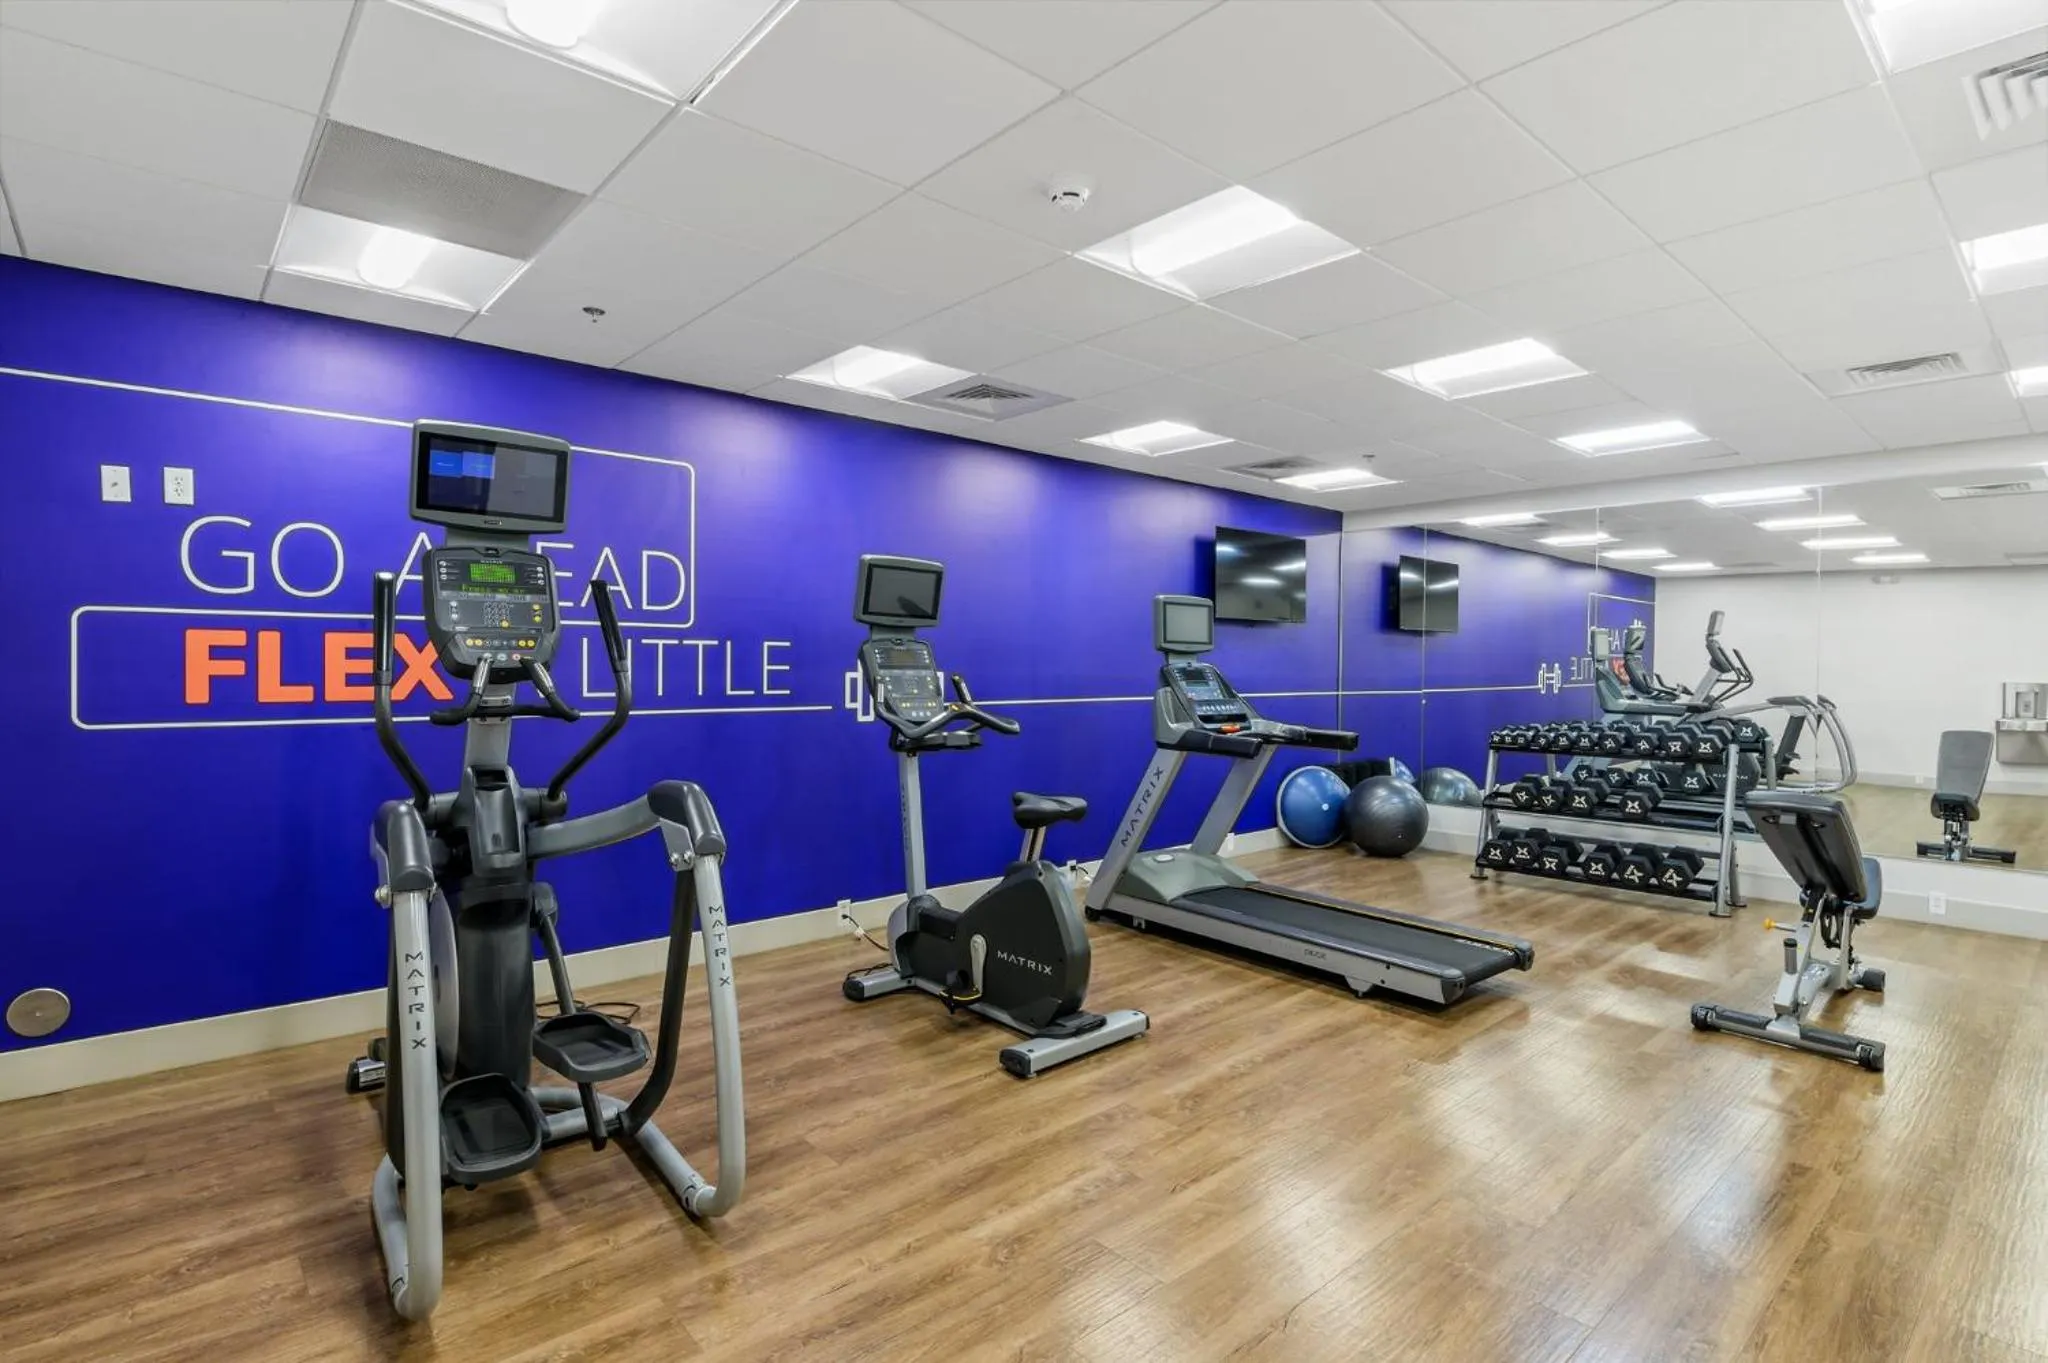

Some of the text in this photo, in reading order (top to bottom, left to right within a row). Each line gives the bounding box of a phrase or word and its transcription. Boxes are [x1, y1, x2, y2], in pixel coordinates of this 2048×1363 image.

[180, 515, 686, 611] GO AEAD
[185, 628, 791, 704] FLEX LITTLE
[1120, 765, 1164, 848] MATRIX
[708, 905, 731, 987] MATRIX
[997, 949, 1053, 976] MATRIX
[405, 951, 427, 1050] MATRIX
